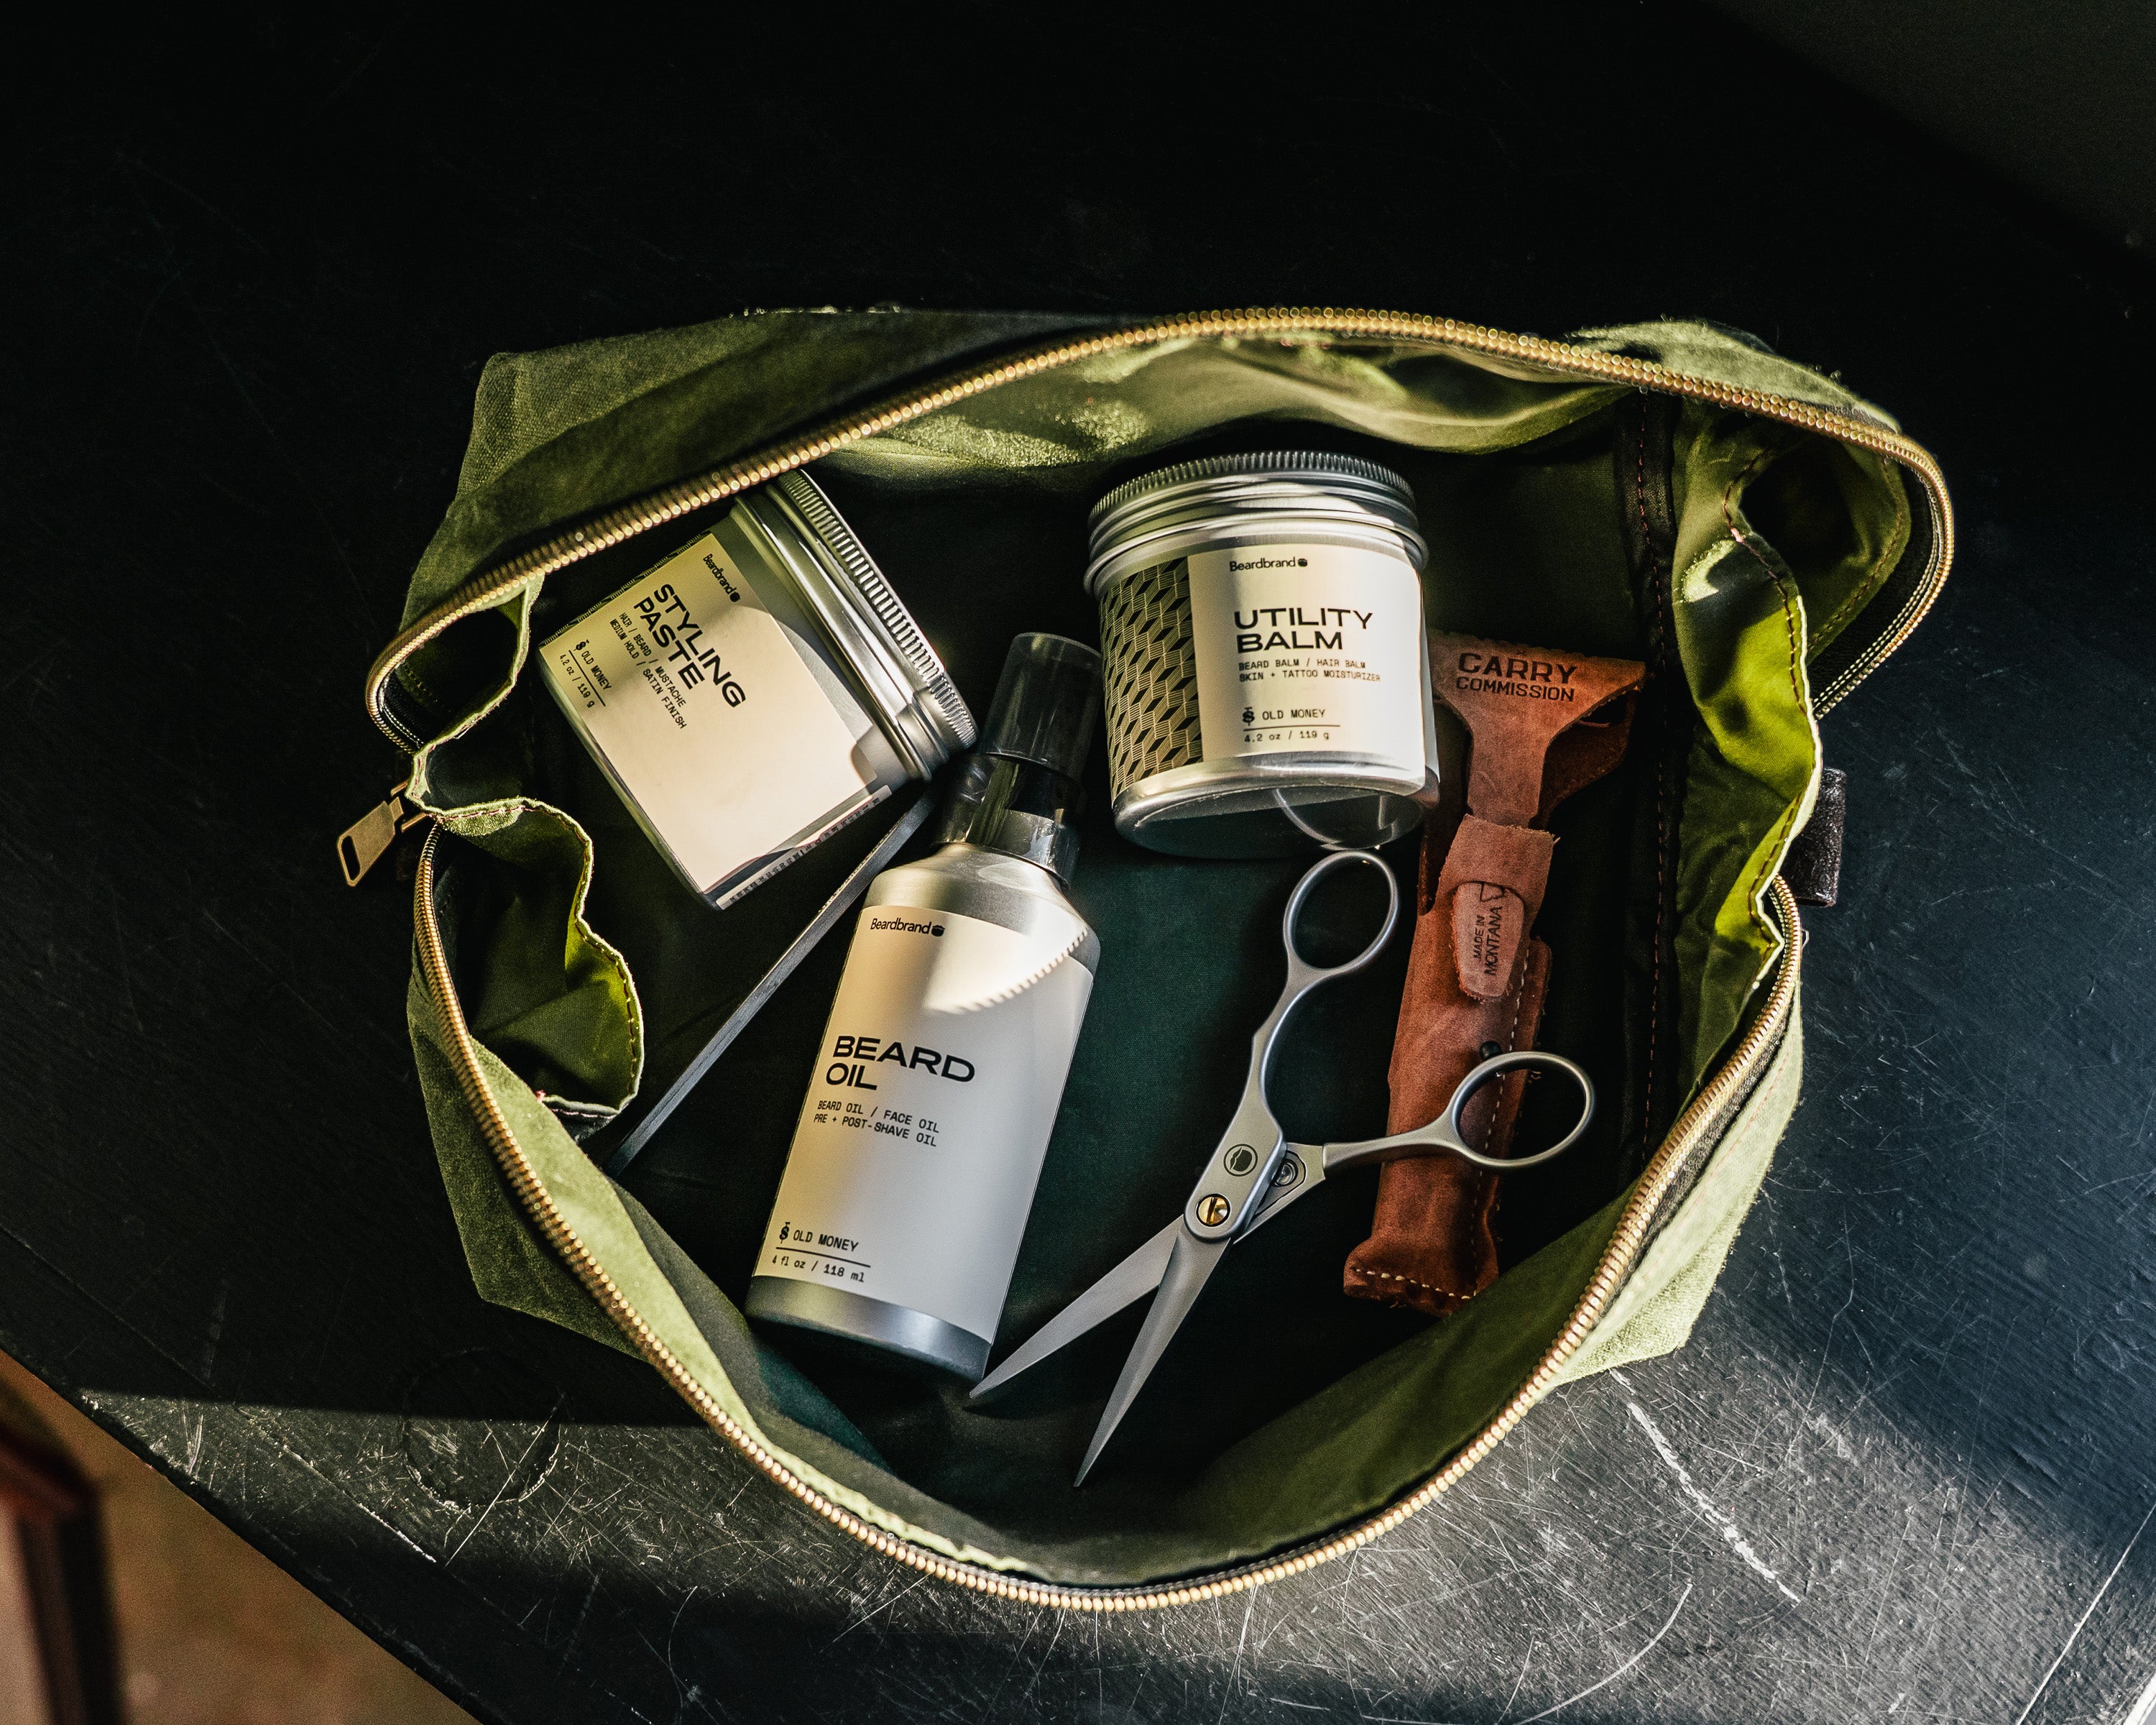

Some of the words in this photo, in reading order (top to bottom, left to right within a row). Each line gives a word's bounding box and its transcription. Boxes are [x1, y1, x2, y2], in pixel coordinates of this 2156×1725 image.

[703, 553, 734, 595] Beardbrand
[1229, 557, 1296, 572] Beardbrand
[1234, 607, 1373, 630] UTILITY
[633, 597, 706, 690] PASTE
[653, 584, 746, 708] STYLING
[1236, 631, 1343, 654] BALM
[581, 650, 596, 665] OLD
[591, 664, 612, 691] MONEY
[619, 612, 632, 627] HAIR
[633, 633, 653, 657] BEARD
[655, 666, 686, 707] MUSTACHE
[1238, 660, 1269, 671] BEARD
[1276, 658, 1299, 668] BALM
[1306, 658, 1310, 667] /
[1345, 661, 1365, 669] BALM
[1458, 653, 1577, 684] CARRY
[559, 653, 571, 666] 4.2
[566, 666, 575, 676] oz
[577, 683, 591, 697] 119
[609, 620, 627, 641] MEDIUM
[624, 640, 639, 659] HOLD
[642, 668, 663, 694] SATIN
[661, 696, 687, 730] FINISH
[1239, 672, 1264, 682] SKIN
[1283, 669, 1318, 679] TATTOO
[1324, 671, 1381, 682] MOISTURIZER
[1456, 676, 1575, 702] COMMISSION
[1262, 710, 1284, 720] OLD
[1291, 709, 1326, 718] MONEY
[1244, 733, 1263, 743] 4.2
[1288, 731, 1292, 740] /
[1299, 731, 1317, 740] 119
[870, 918, 932, 935] Beardbrand
[1476, 914, 1485, 926] IN
[1473, 928, 1484, 960] MADE
[1483, 906, 1503, 976] MONTANA
[832, 1036, 975, 1082] BEARD
[825, 1062, 877, 1090] OIL
[814, 1114, 828, 1123] PRE
[842, 1116, 910, 1138] POST-SHAVE
[916, 1132, 937, 1147] OIL
[817, 1100, 842, 1111] BEARD
[846, 1103, 864, 1114] OIL
[870, 1106, 878, 1117] /
[883, 1109, 913, 1126] FACE
[918, 1118, 940, 1133] OIL
[793, 1230, 813, 1243] OLD
[818, 1234, 859, 1252] MONEY
[772, 1255, 777, 1264] 4
[780, 1256, 789, 1266] fl
[794, 1260, 806, 1269] oz
[811, 1260, 819, 1271] /
[824, 1264, 844, 1277] 118
[850, 1272, 865, 1283] ml
